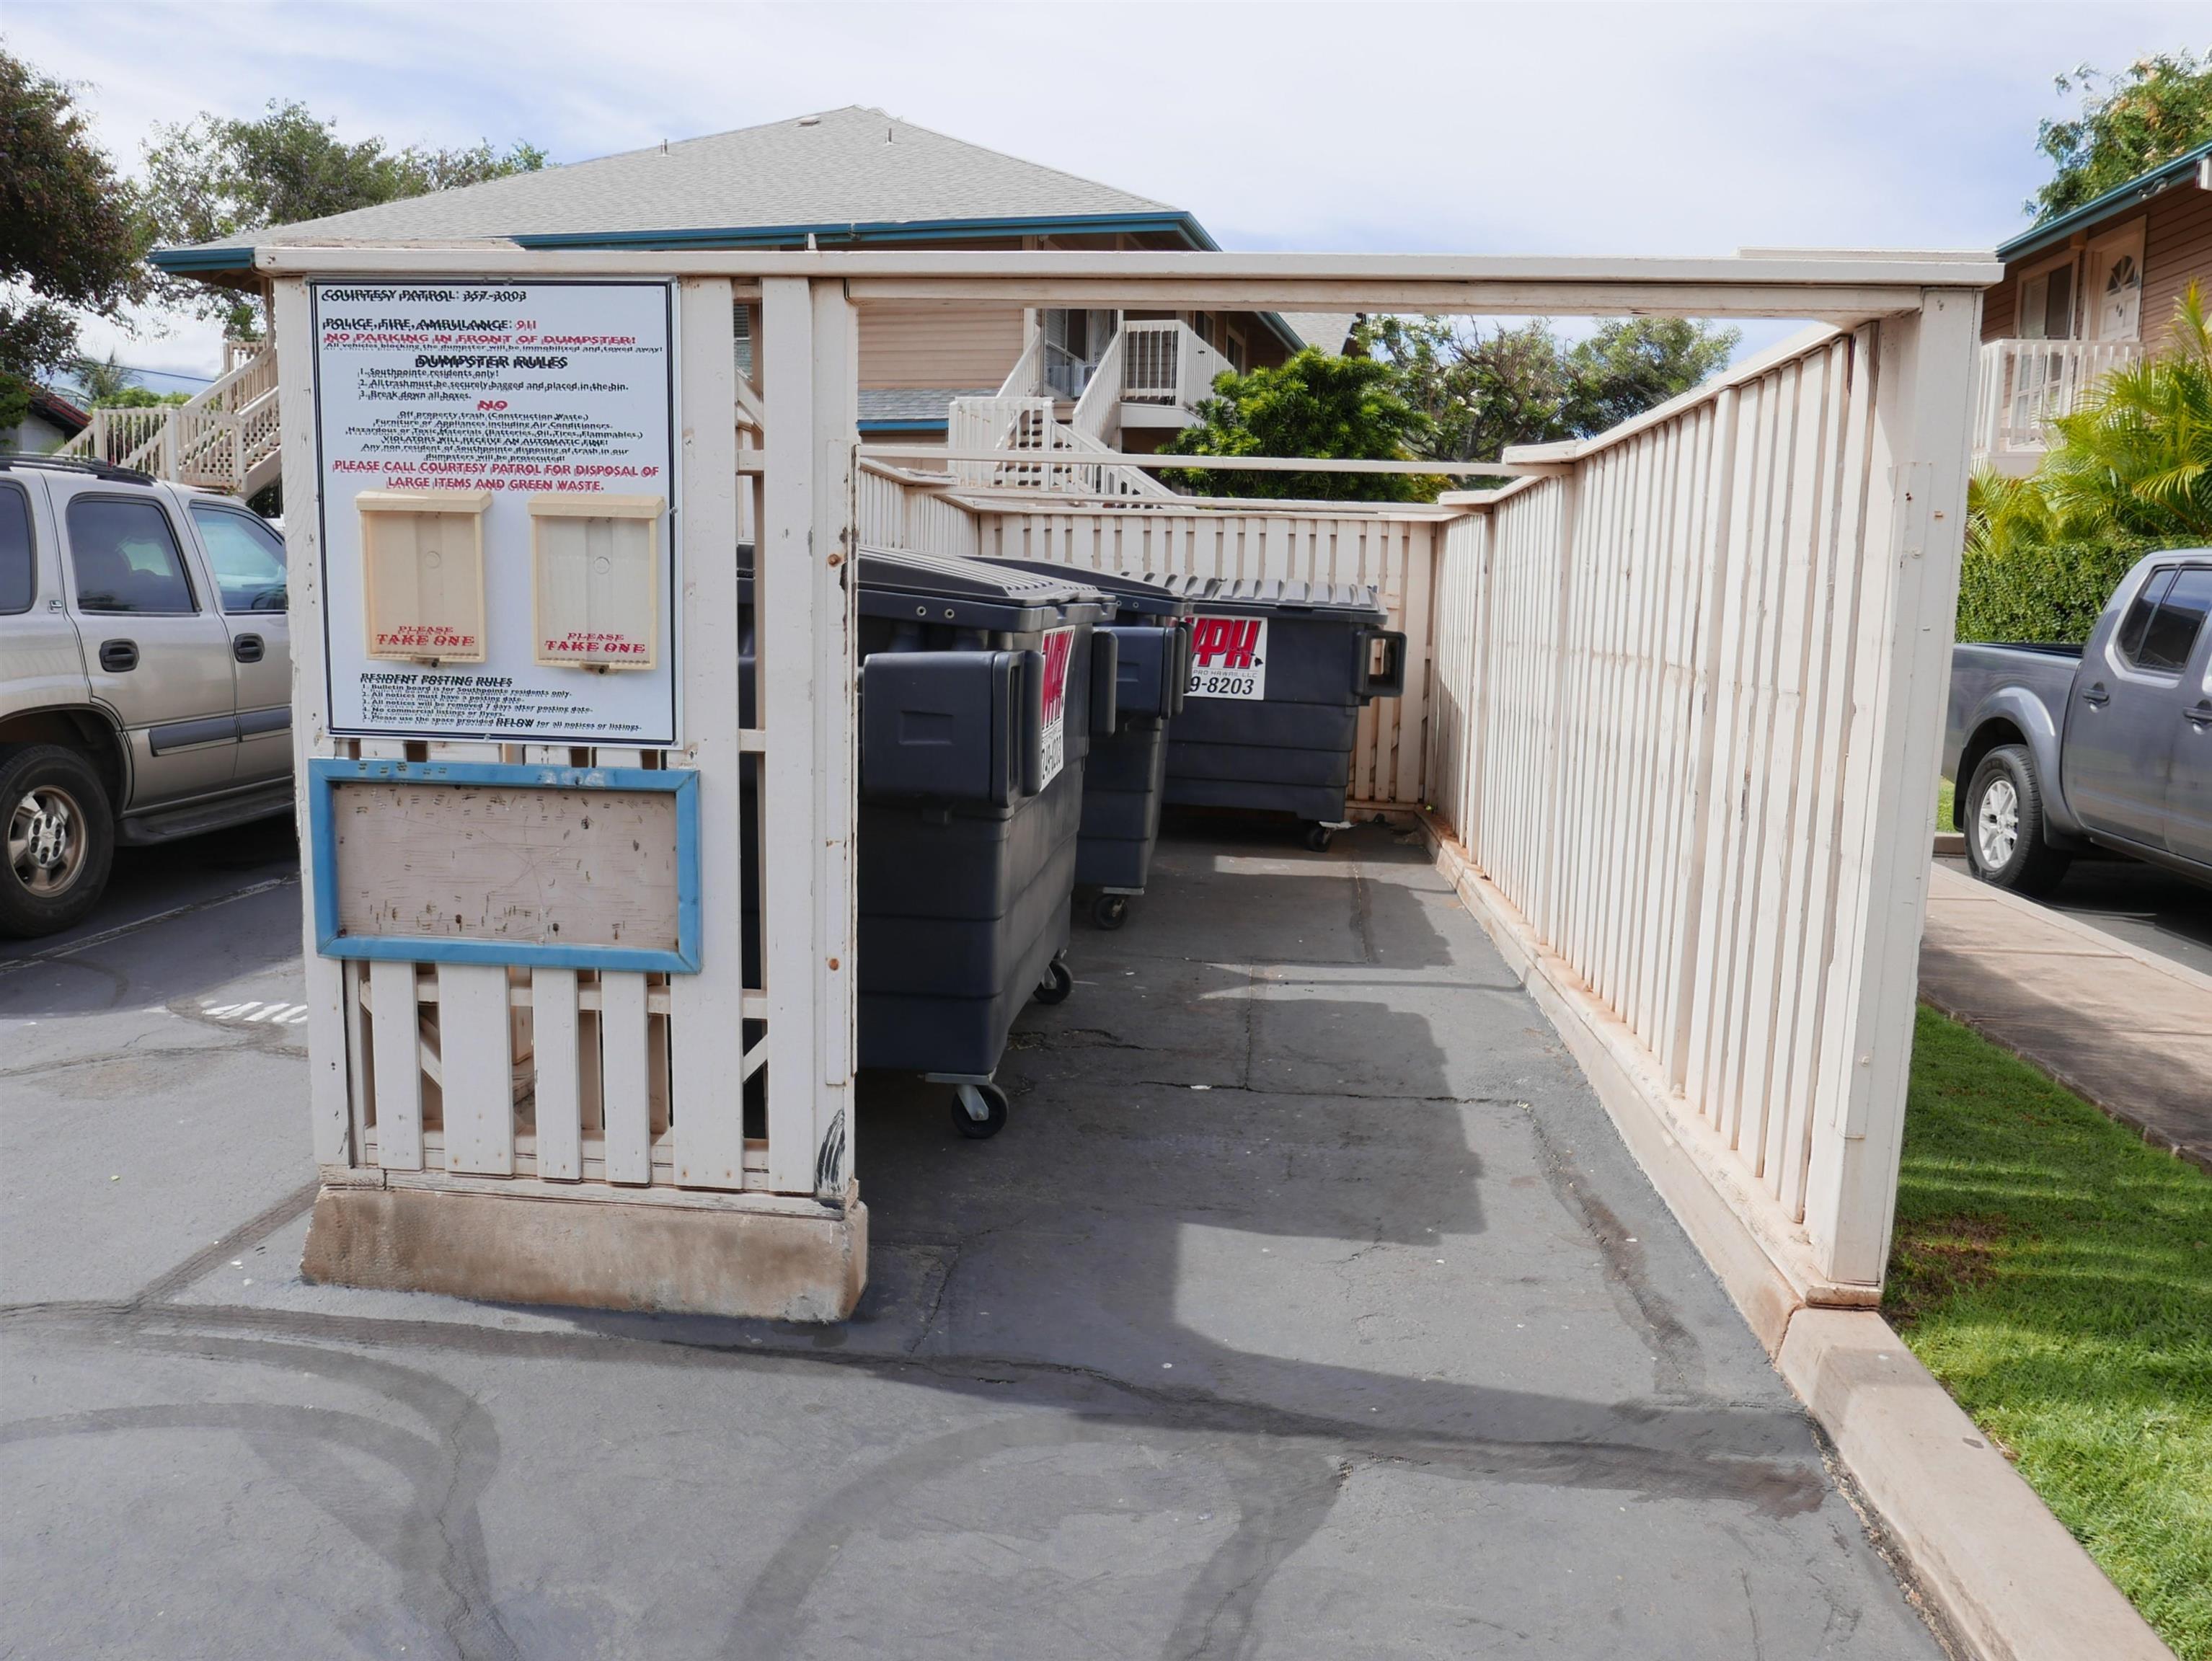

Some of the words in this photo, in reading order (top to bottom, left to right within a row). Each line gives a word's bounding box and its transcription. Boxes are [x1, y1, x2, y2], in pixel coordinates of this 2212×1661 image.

[322, 290, 397, 301] COURTESY
[399, 290, 459, 301] PATROL:
[462, 291, 527, 302] 357-3003
[323, 319, 376, 331] POLICE,
[379, 319, 415, 331] FIRE,
[416, 319, 512, 331] AMBULANCE:
[515, 320, 536, 330] 911
[324, 333, 350, 343] NO
[353, 333, 428, 343] PARKING
[433, 334, 452, 344] IN
[456, 335, 512, 344] FRONT
[516, 335, 538, 345] OF
[541, 335, 636, 345] DUMPSTER!
[380, 342, 420, 352] blocking
[441, 343, 485, 353] dumpster
[415, 355, 510, 368] DUMPSTER
[513, 355, 567, 368] RULES
[368, 368, 427, 379] Southpointe
[429, 369, 472, 378] residents
[472, 370, 499, 380] only!
[370, 379, 383, 389] All
[384, 380, 407, 389] trash
[407, 381, 433, 390] must
[435, 381, 447, 390] be
[450, 381, 487, 391] securely
[489, 381, 523, 391] bagged
[526, 382, 544, 391] and
[545, 382, 577, 392] placed
[579, 383, 588, 391] in
[590, 383, 607, 392] the
[609, 383, 629, 392] bin.
[368, 390, 397, 400] Break
[399, 391, 425, 401] down
[428, 392, 439, 401] all
[441, 392, 472, 402] boxes.
[477, 400, 508, 411] NO
[415, 412, 457, 421] property
[487, 412, 552, 421] (Construction
[436, 420, 485, 428] Appliances
[487, 421, 530, 430] including
[548, 422, 613, 430] Conditioners.
[362, 443, 381, 452] Any
[403, 444, 441, 453] resident
[455, 445, 512, 455] Southpointe
[513, 446, 558, 456] disposing
[424, 453, 474, 462] dumpsters
[508, 455, 565, 464] prosecuted!
[333, 460, 380, 473] PLEASE
[383, 461, 416, 474] CALL
[419, 462, 487, 474] COURTESY
[490, 463, 541, 476] PATROL
[544, 464, 571, 476] FOR
[574, 465, 638, 477] DISPOSAL
[641, 466, 659, 477] OF
[386, 477, 430, 489] LARGE
[433, 478, 472, 490] ITEMS
[474, 479, 505, 491] AND
[508, 479, 553, 492] GREEN
[555, 481, 604, 492] WASTE.
[398, 626, 454, 634] PLEASE
[376, 634, 428, 646] TAKE
[433, 635, 474, 646] ONE
[567, 632, 624, 642] PLEASE
[544, 640, 599, 652] TAKE
[604, 642, 645, 653] ONE
[360, 673, 418, 684] RESIDENT
[421, 676, 473, 686] POSTING
[476, 677, 513, 687] RULES
[457, 687, 508, 696] Southpointe
[552, 690, 572, 699] only.
[456, 718, 494, 727] provided
[609, 723, 642, 732] listings.
